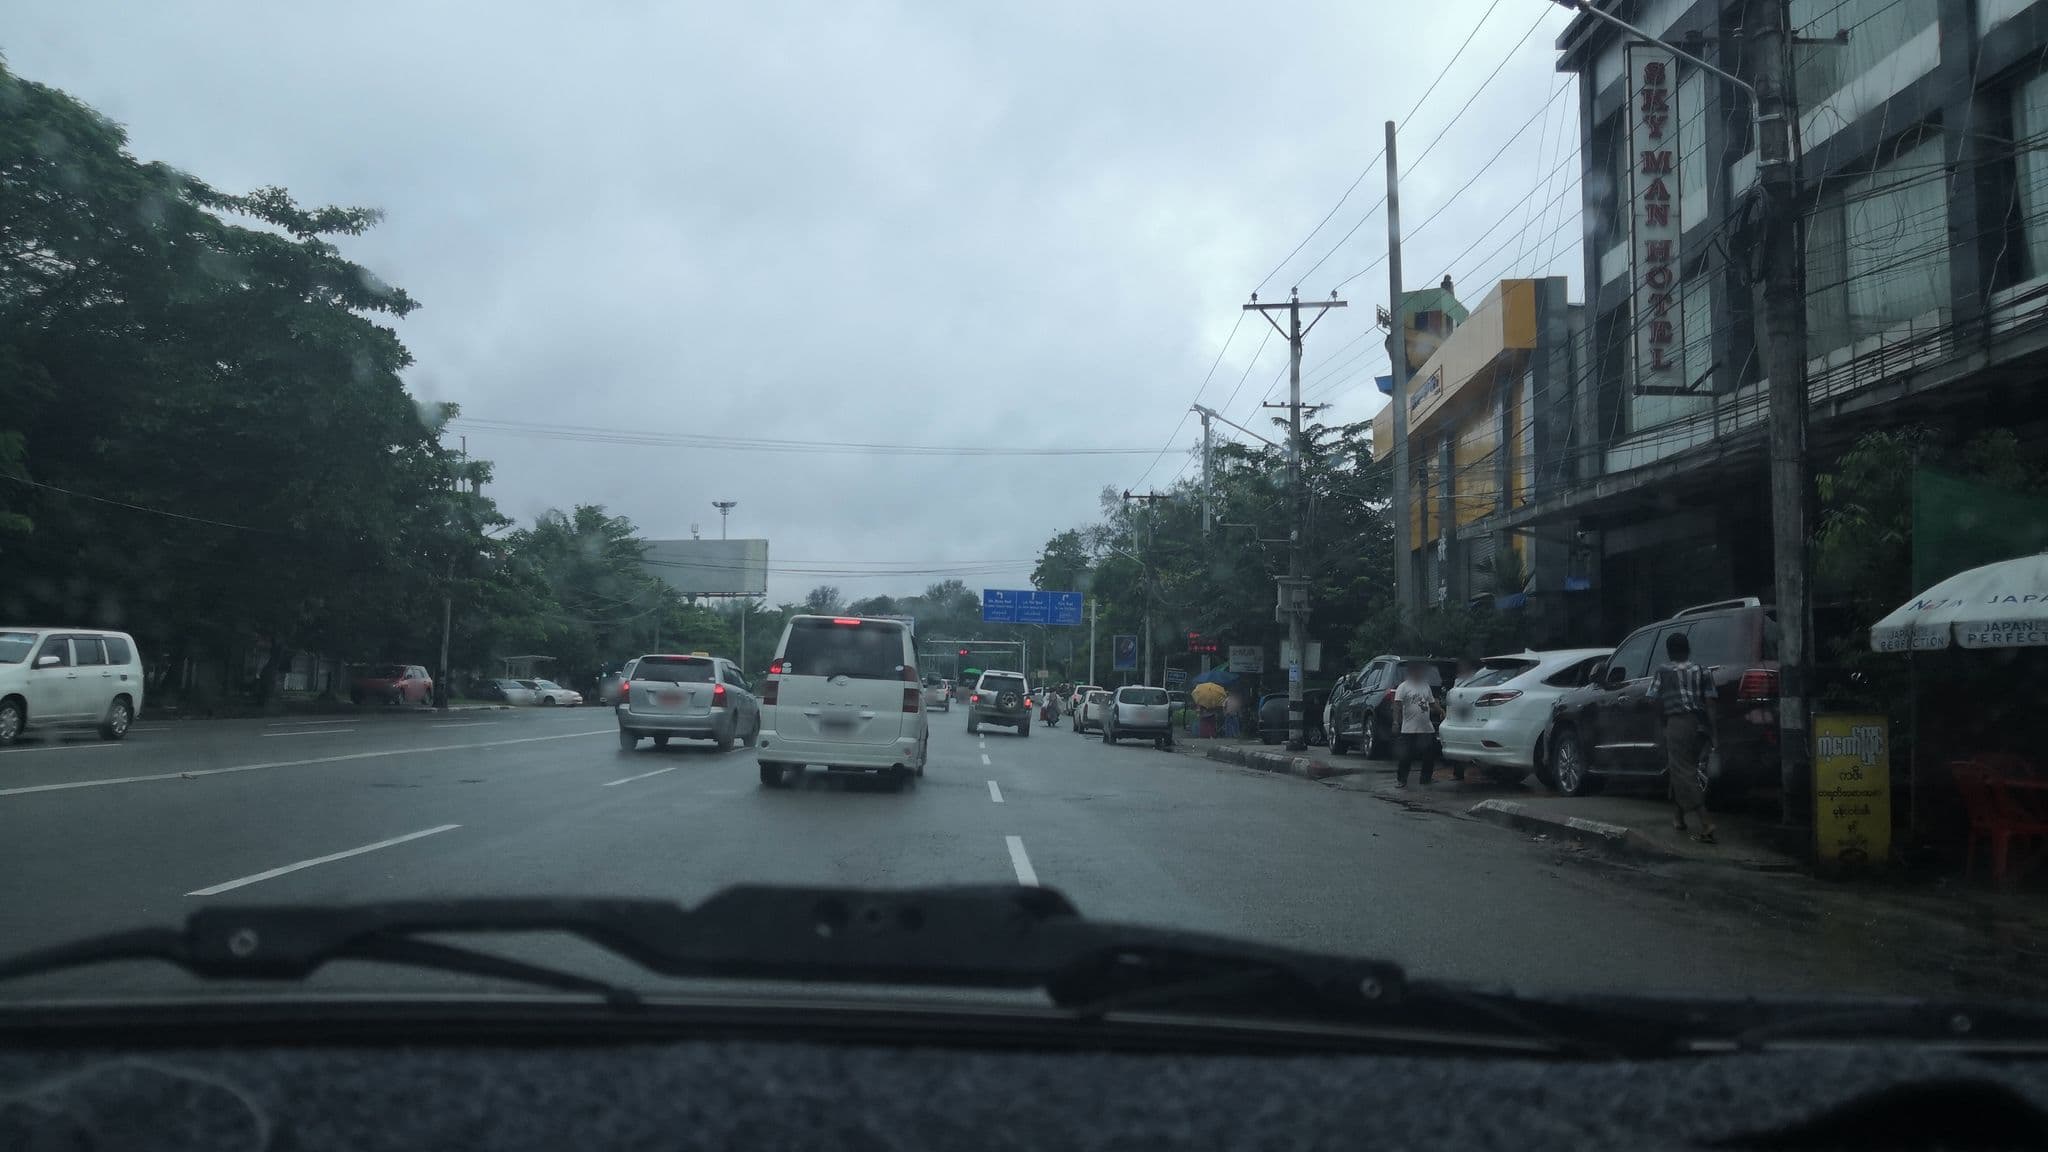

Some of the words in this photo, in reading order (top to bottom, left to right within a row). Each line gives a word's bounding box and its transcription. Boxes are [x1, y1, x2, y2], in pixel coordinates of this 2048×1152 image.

[1641, 62, 1669, 139] SKY
[1640, 151, 1672, 225] MAN
[1644, 239, 1674, 371] HOTEL
